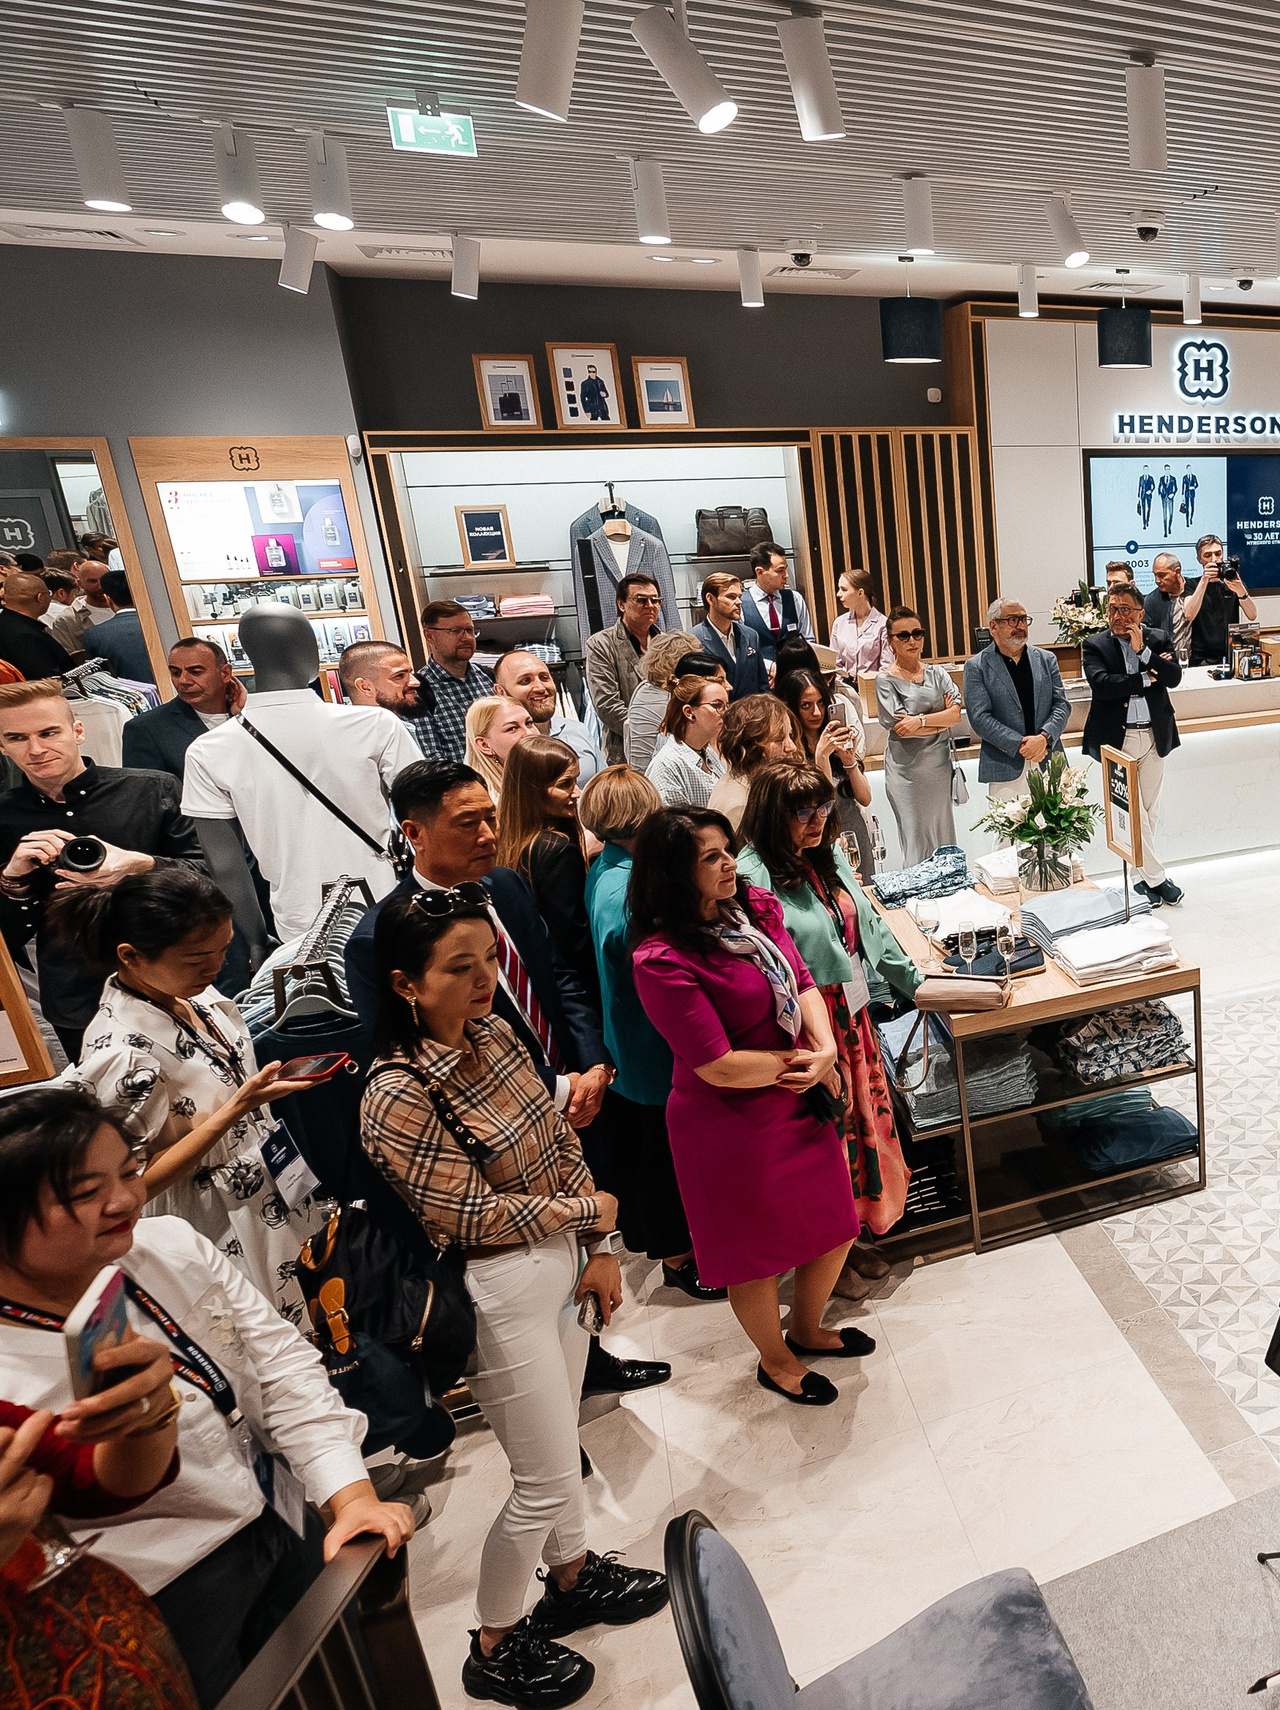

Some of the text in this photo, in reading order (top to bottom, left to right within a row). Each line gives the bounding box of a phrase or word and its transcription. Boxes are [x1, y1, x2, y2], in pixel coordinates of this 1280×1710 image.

[1253, 532, 1280, 541] 30 ЛЕТ
[1126, 560, 1150, 568] 2003
